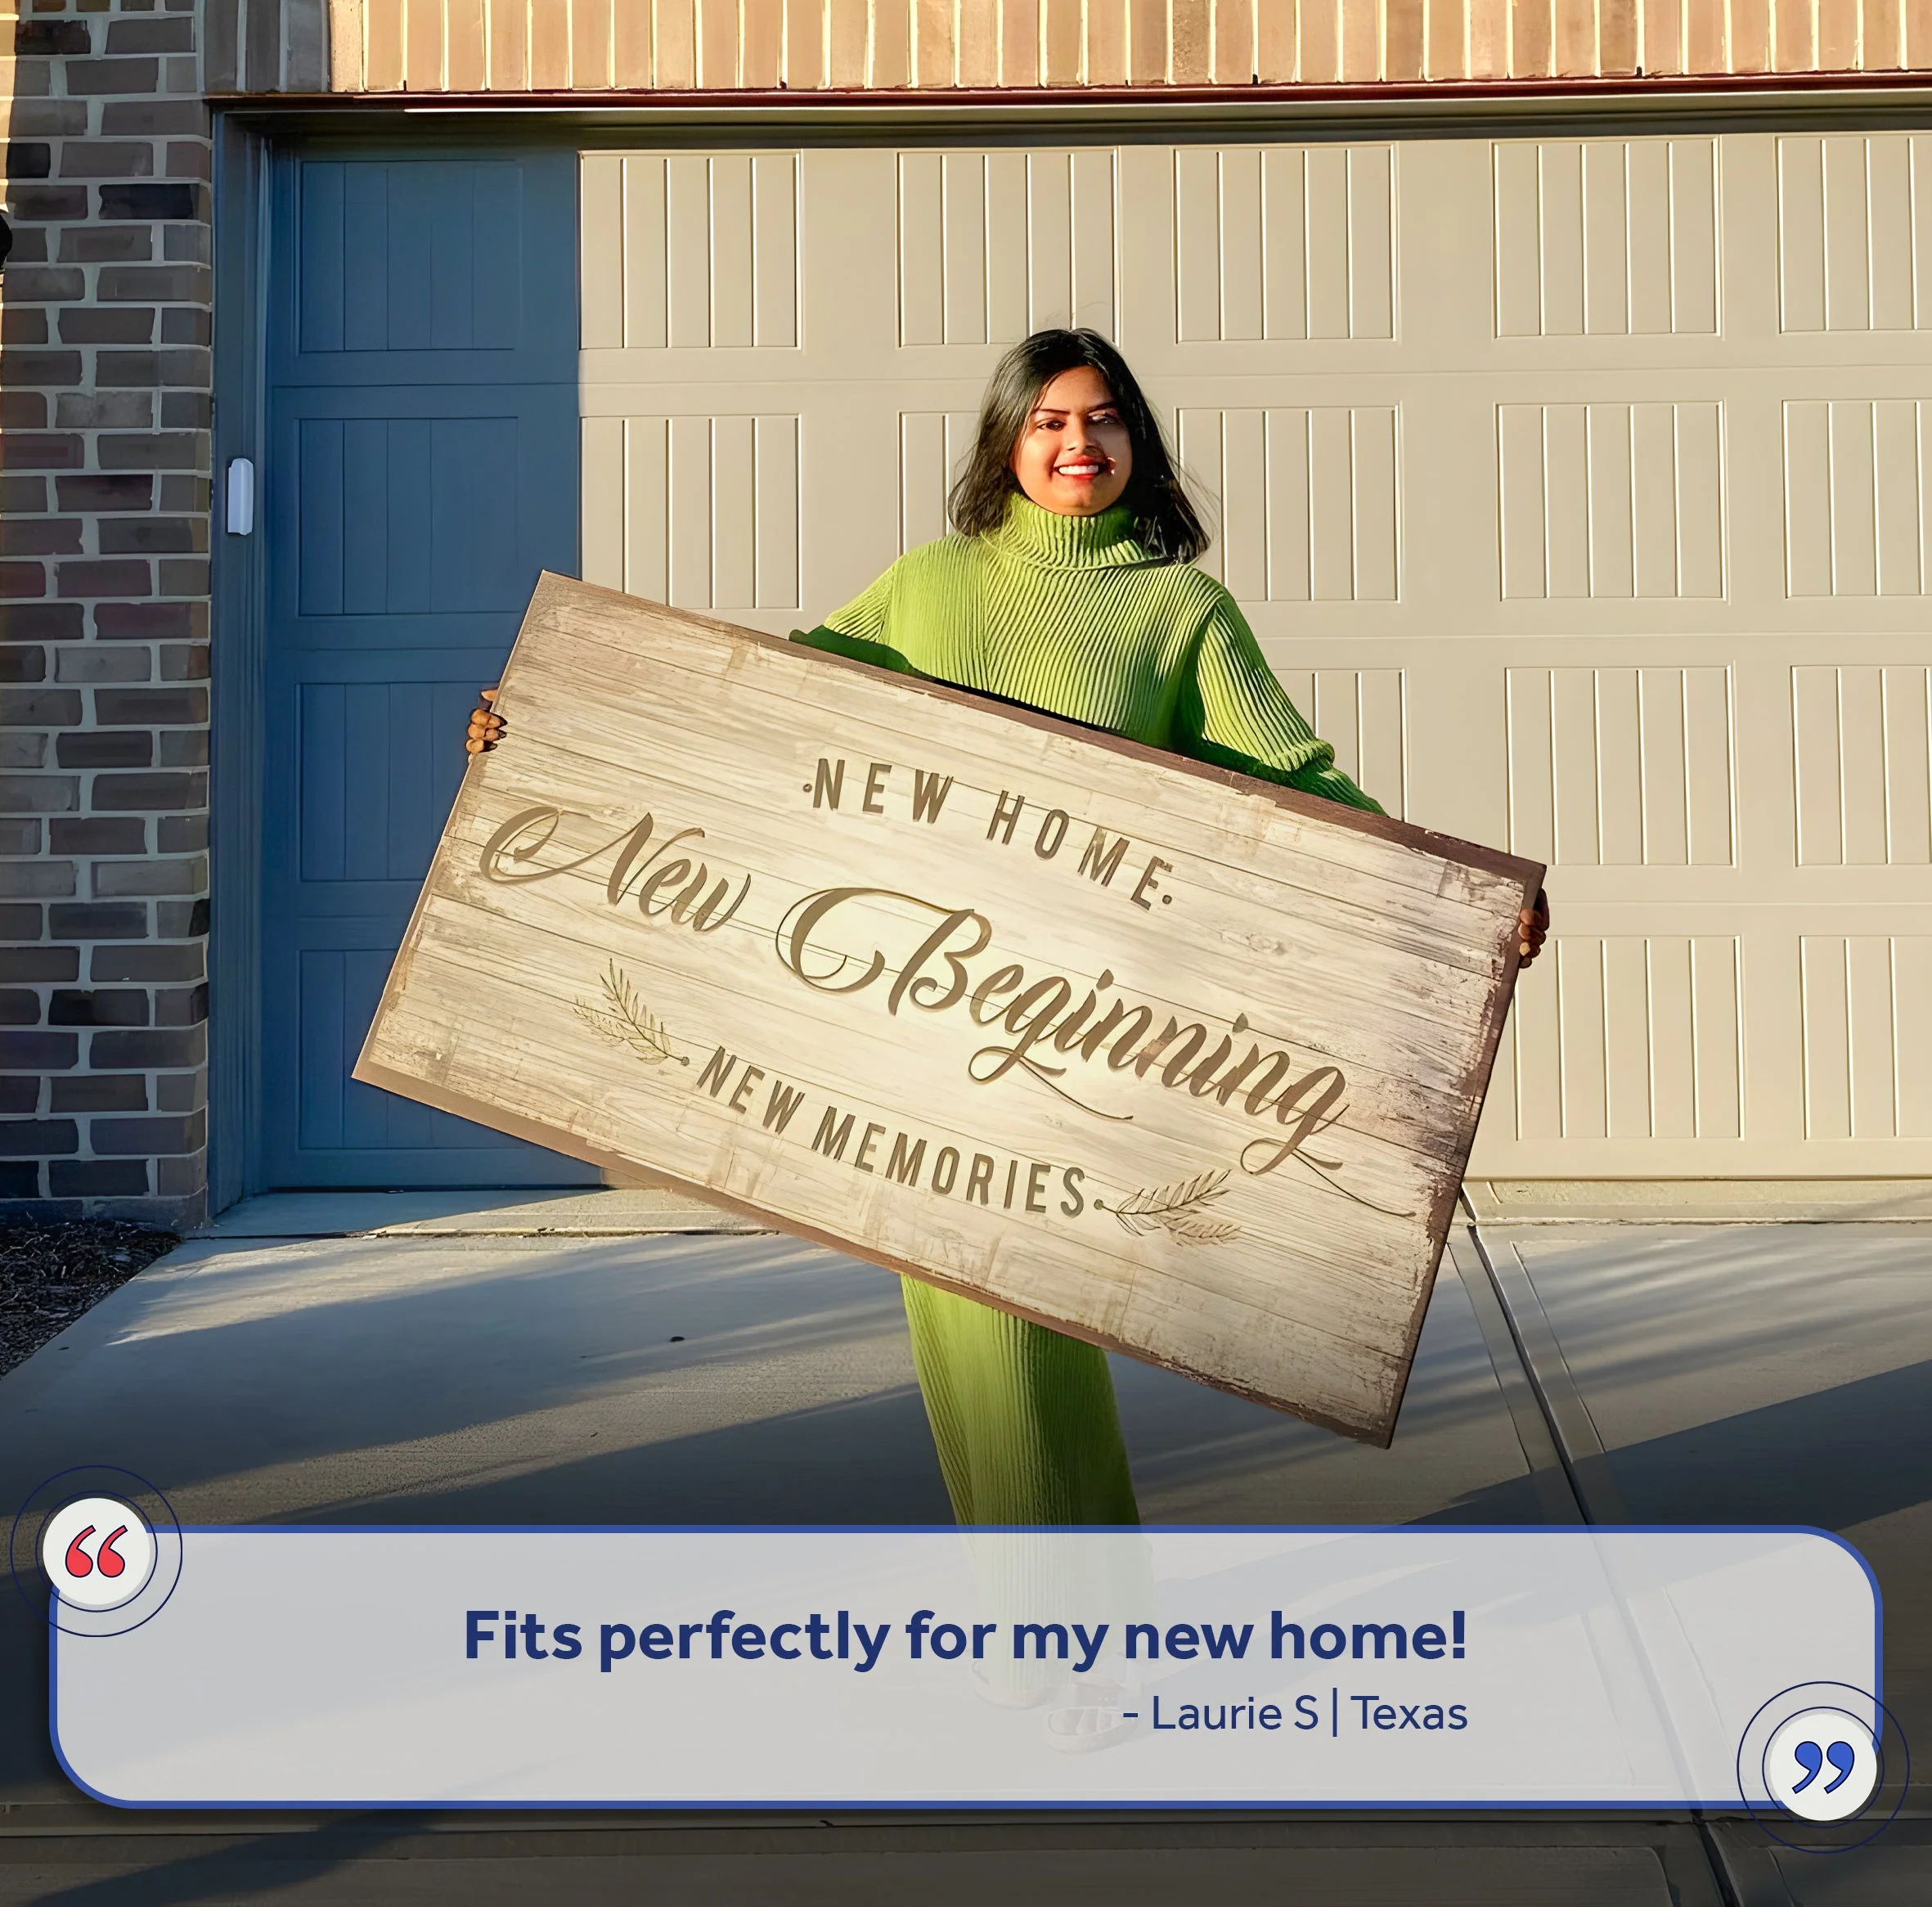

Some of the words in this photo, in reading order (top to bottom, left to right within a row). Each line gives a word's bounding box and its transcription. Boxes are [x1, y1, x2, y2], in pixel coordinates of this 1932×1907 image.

[813, 758, 955, 824] NEW
[986, 789, 1174, 911] HOME
[479, 806, 751, 933] New
[775, 887, 1417, 1217] Beginning
[696, 1046, 805, 1134] NEW
[811, 1105, 1086, 1218] MEMORIES
